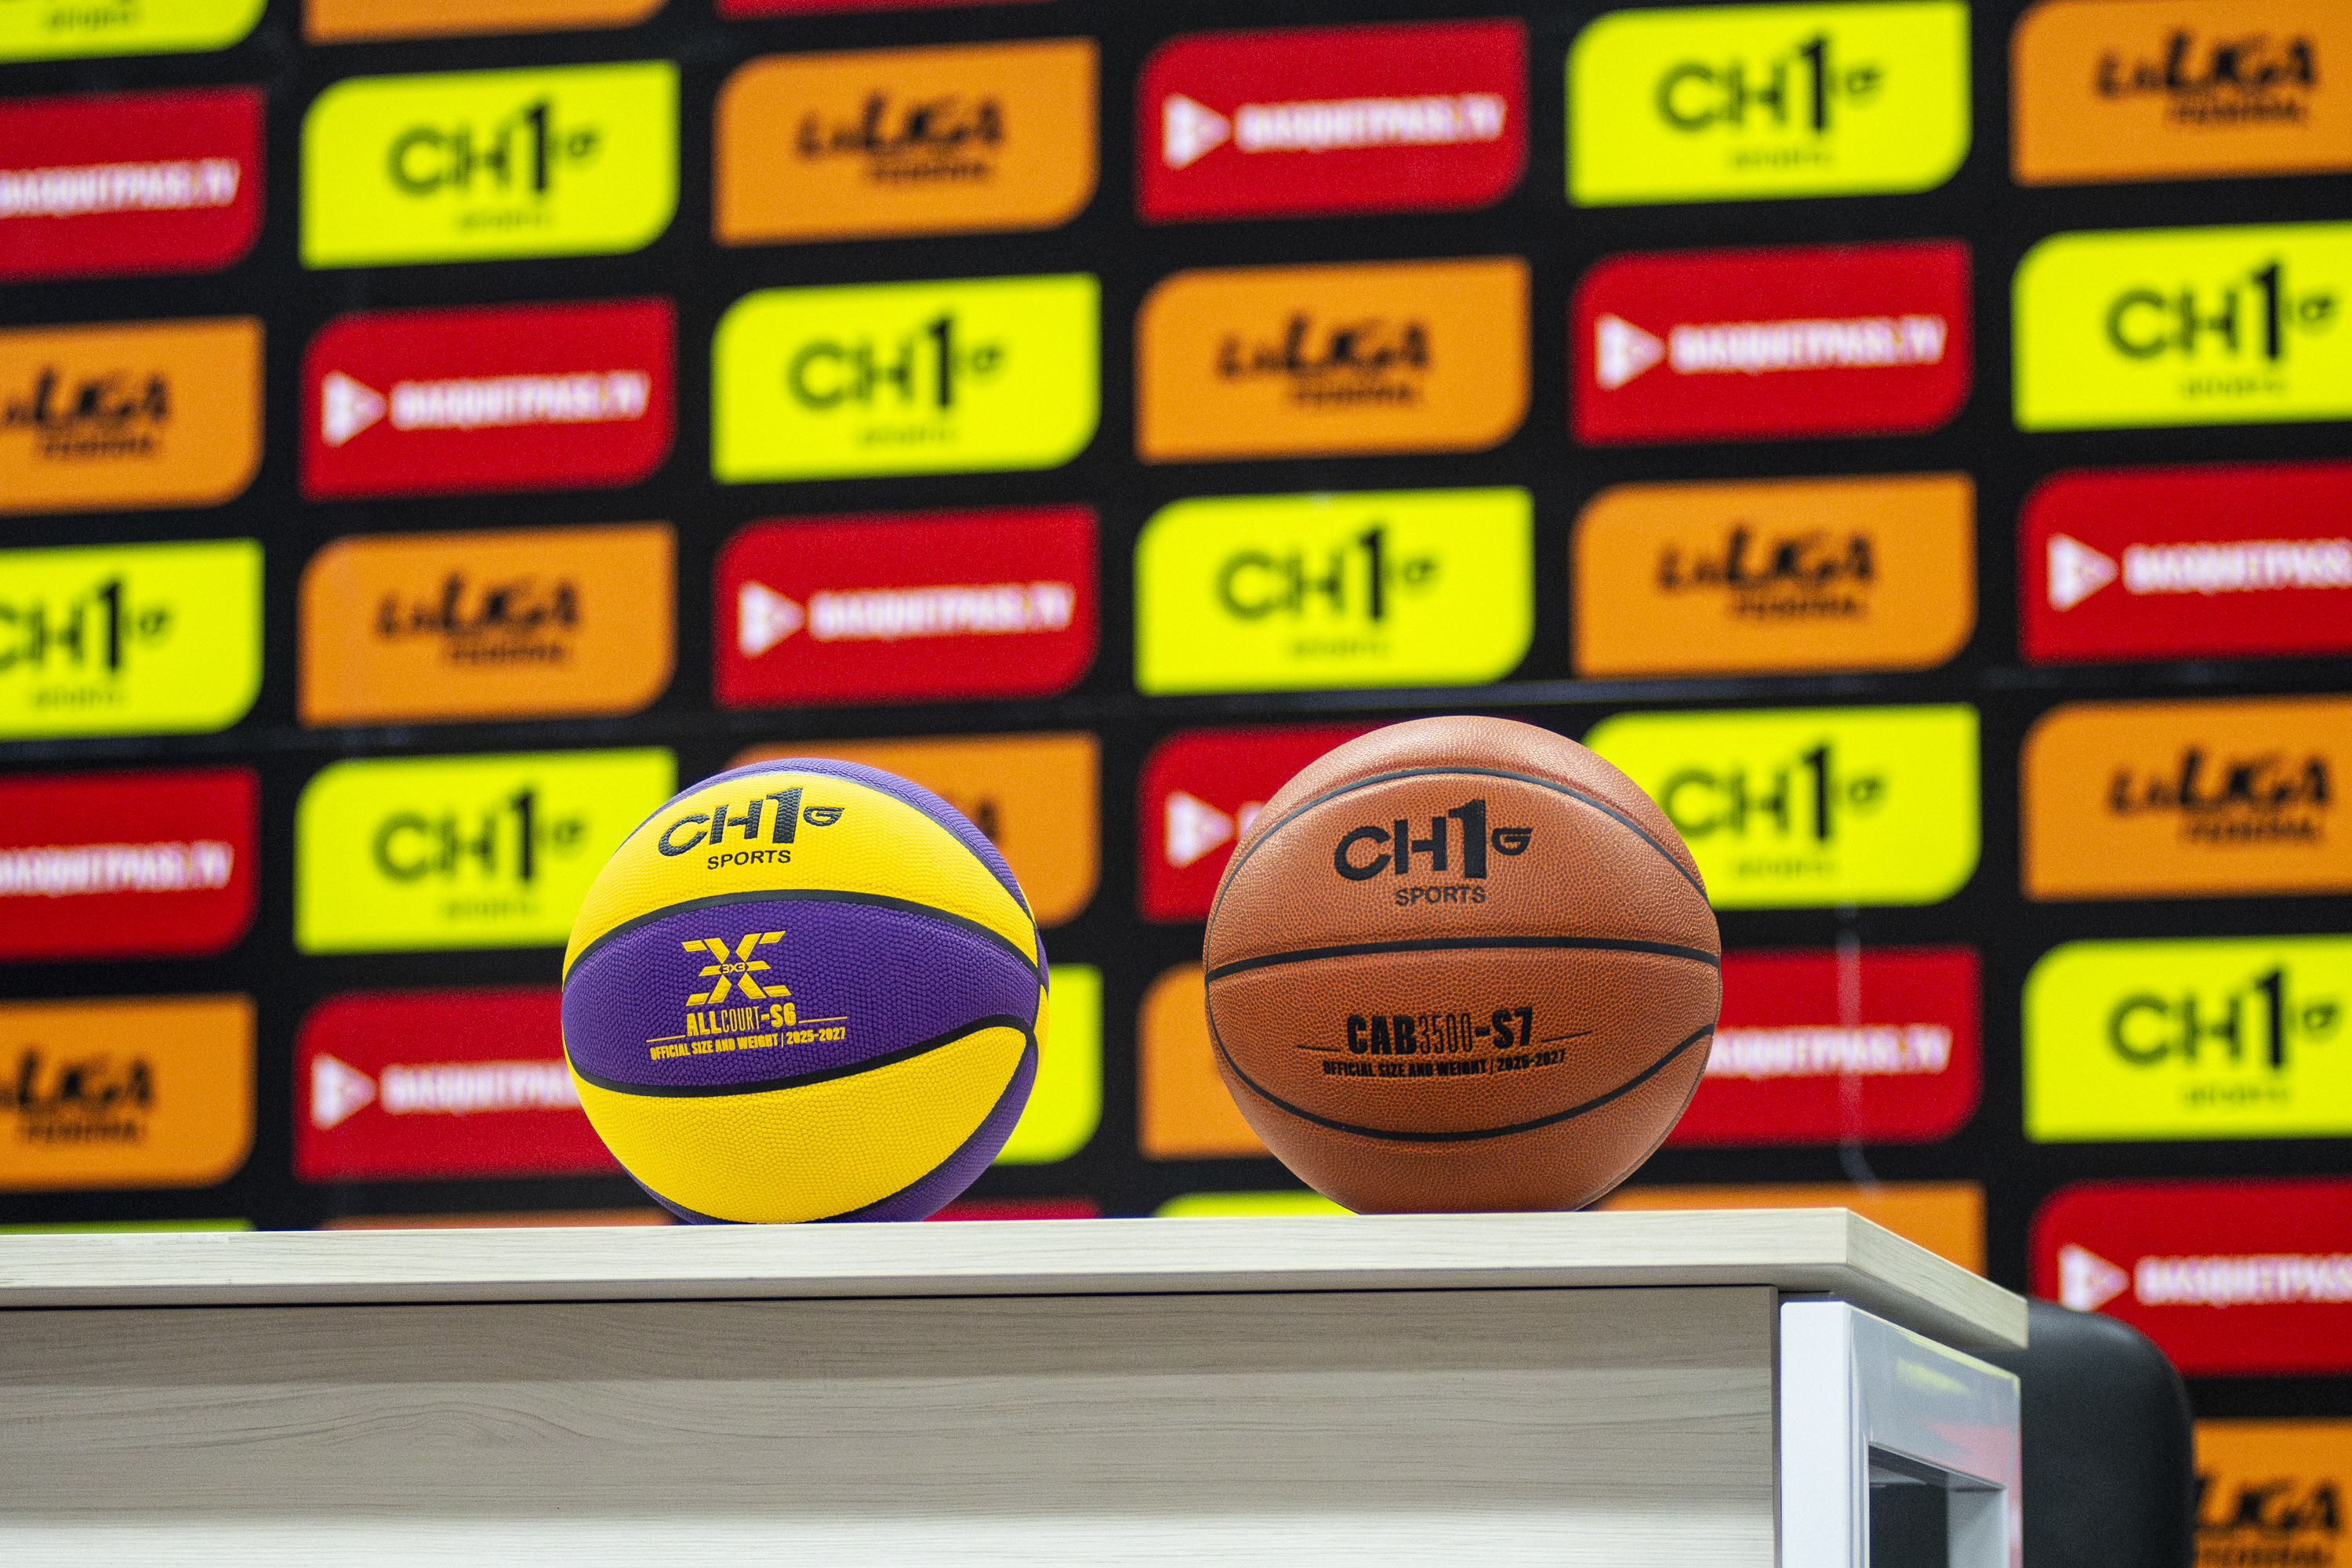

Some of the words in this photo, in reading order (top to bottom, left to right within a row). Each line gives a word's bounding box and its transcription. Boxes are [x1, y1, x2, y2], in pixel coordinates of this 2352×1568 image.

[707, 850, 791, 869] SPORTS
[1396, 886, 1486, 906] SPORTS
[686, 1003, 797, 1036] ALLCOURT-S6
[1346, 1006, 1533, 1055] CAB3500-S7
[650, 1040, 691, 1061] OFFICIAL
[691, 1039, 713, 1055] SIZE
[715, 1037, 735, 1052] AND
[737, 1033, 779, 1050] WEIGHT
[786, 1027, 846, 1045] 2025-2027
[1323, 1060, 1375, 1077] OFFICIAL
[1377, 1062, 1406, 1077] SIZE
[1409, 1061, 1435, 1077] AND
[1436, 1058, 1486, 1076] WEIGHT
